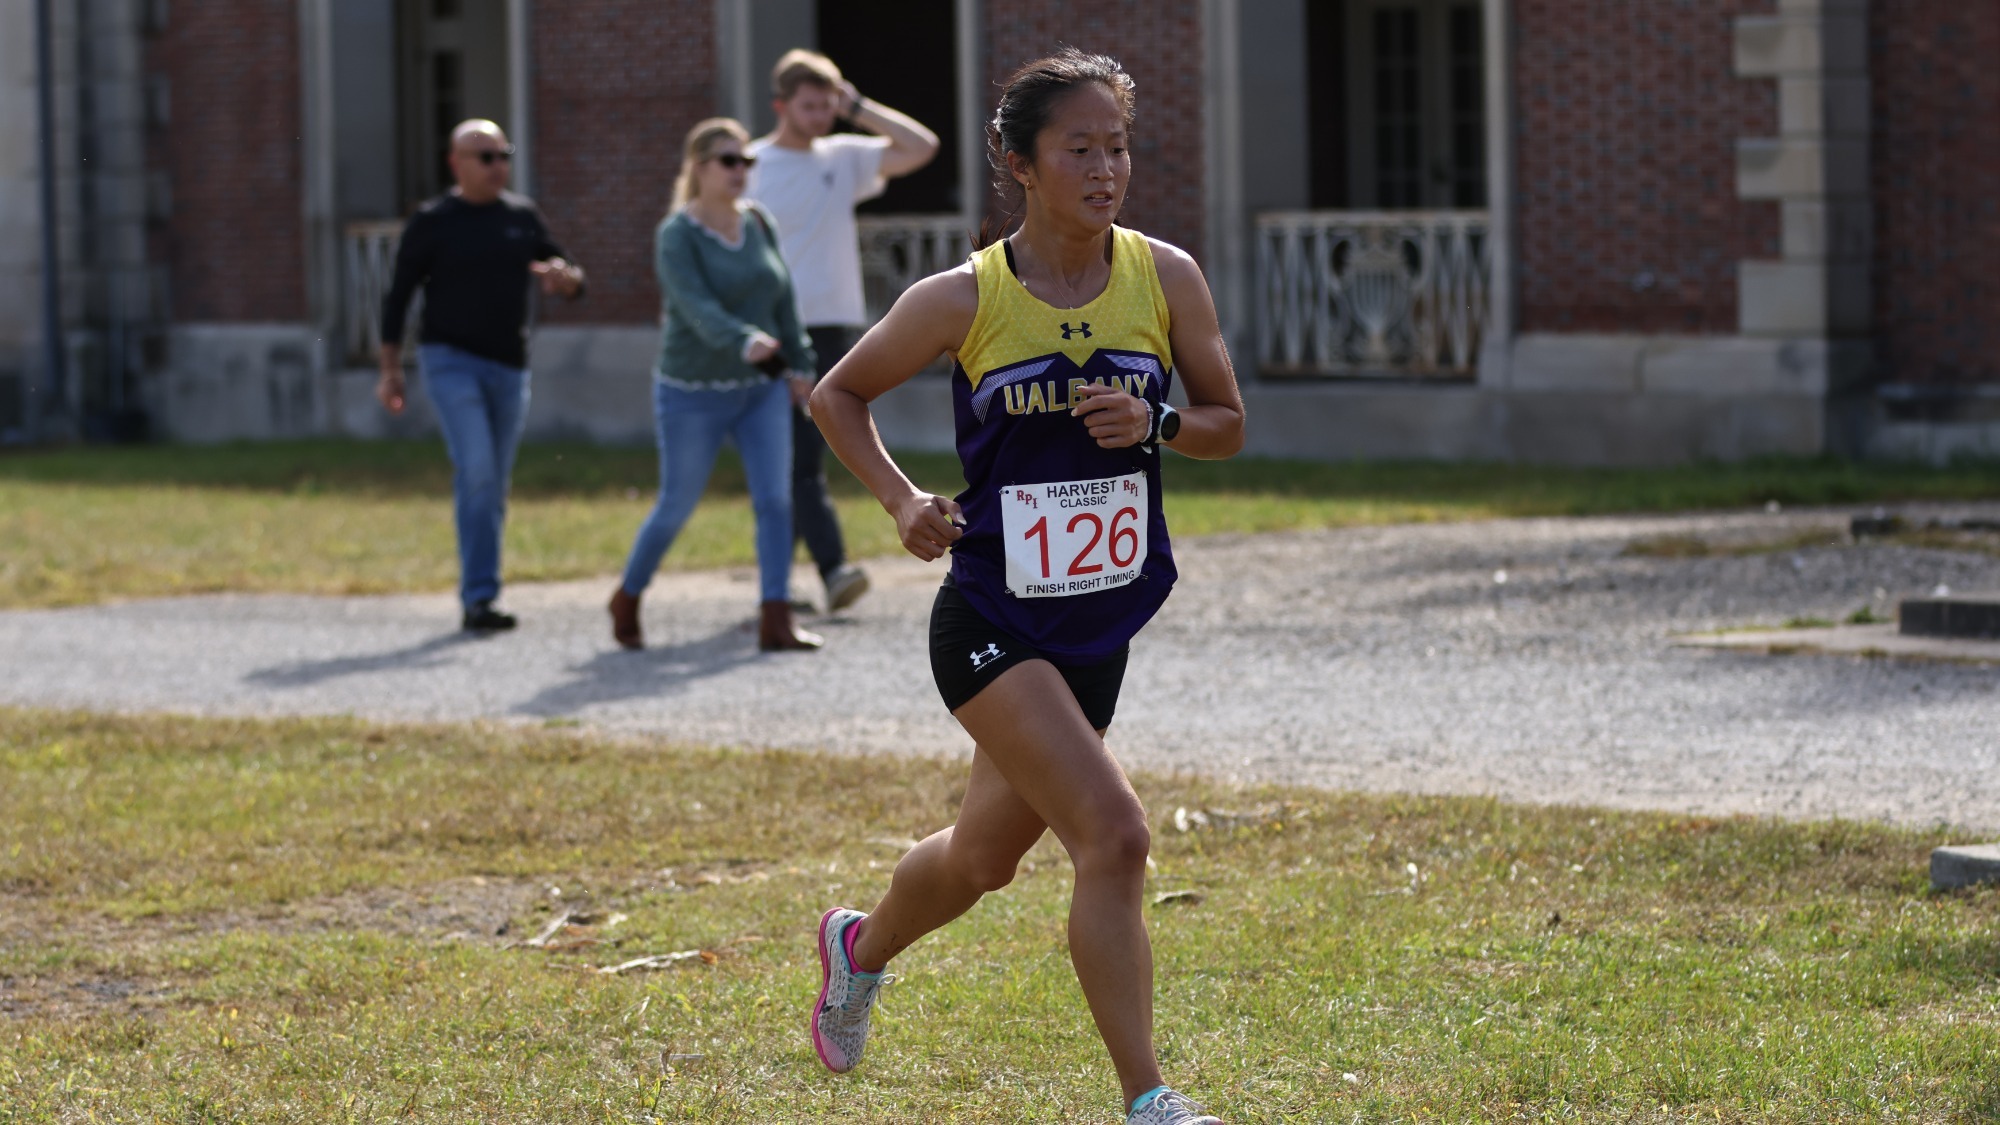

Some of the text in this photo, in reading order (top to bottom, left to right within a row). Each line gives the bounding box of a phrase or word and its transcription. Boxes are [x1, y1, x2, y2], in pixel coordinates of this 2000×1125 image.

[1046, 480, 1117, 498] HARVEST
[1123, 480, 1139, 497] RPI
[1016, 490, 1038, 509] RPI
[1060, 495, 1107, 508] CLASSIC
[1024, 506, 1138, 578] 126
[1026, 570, 1135, 594] FINISH RIGHT TIMING
